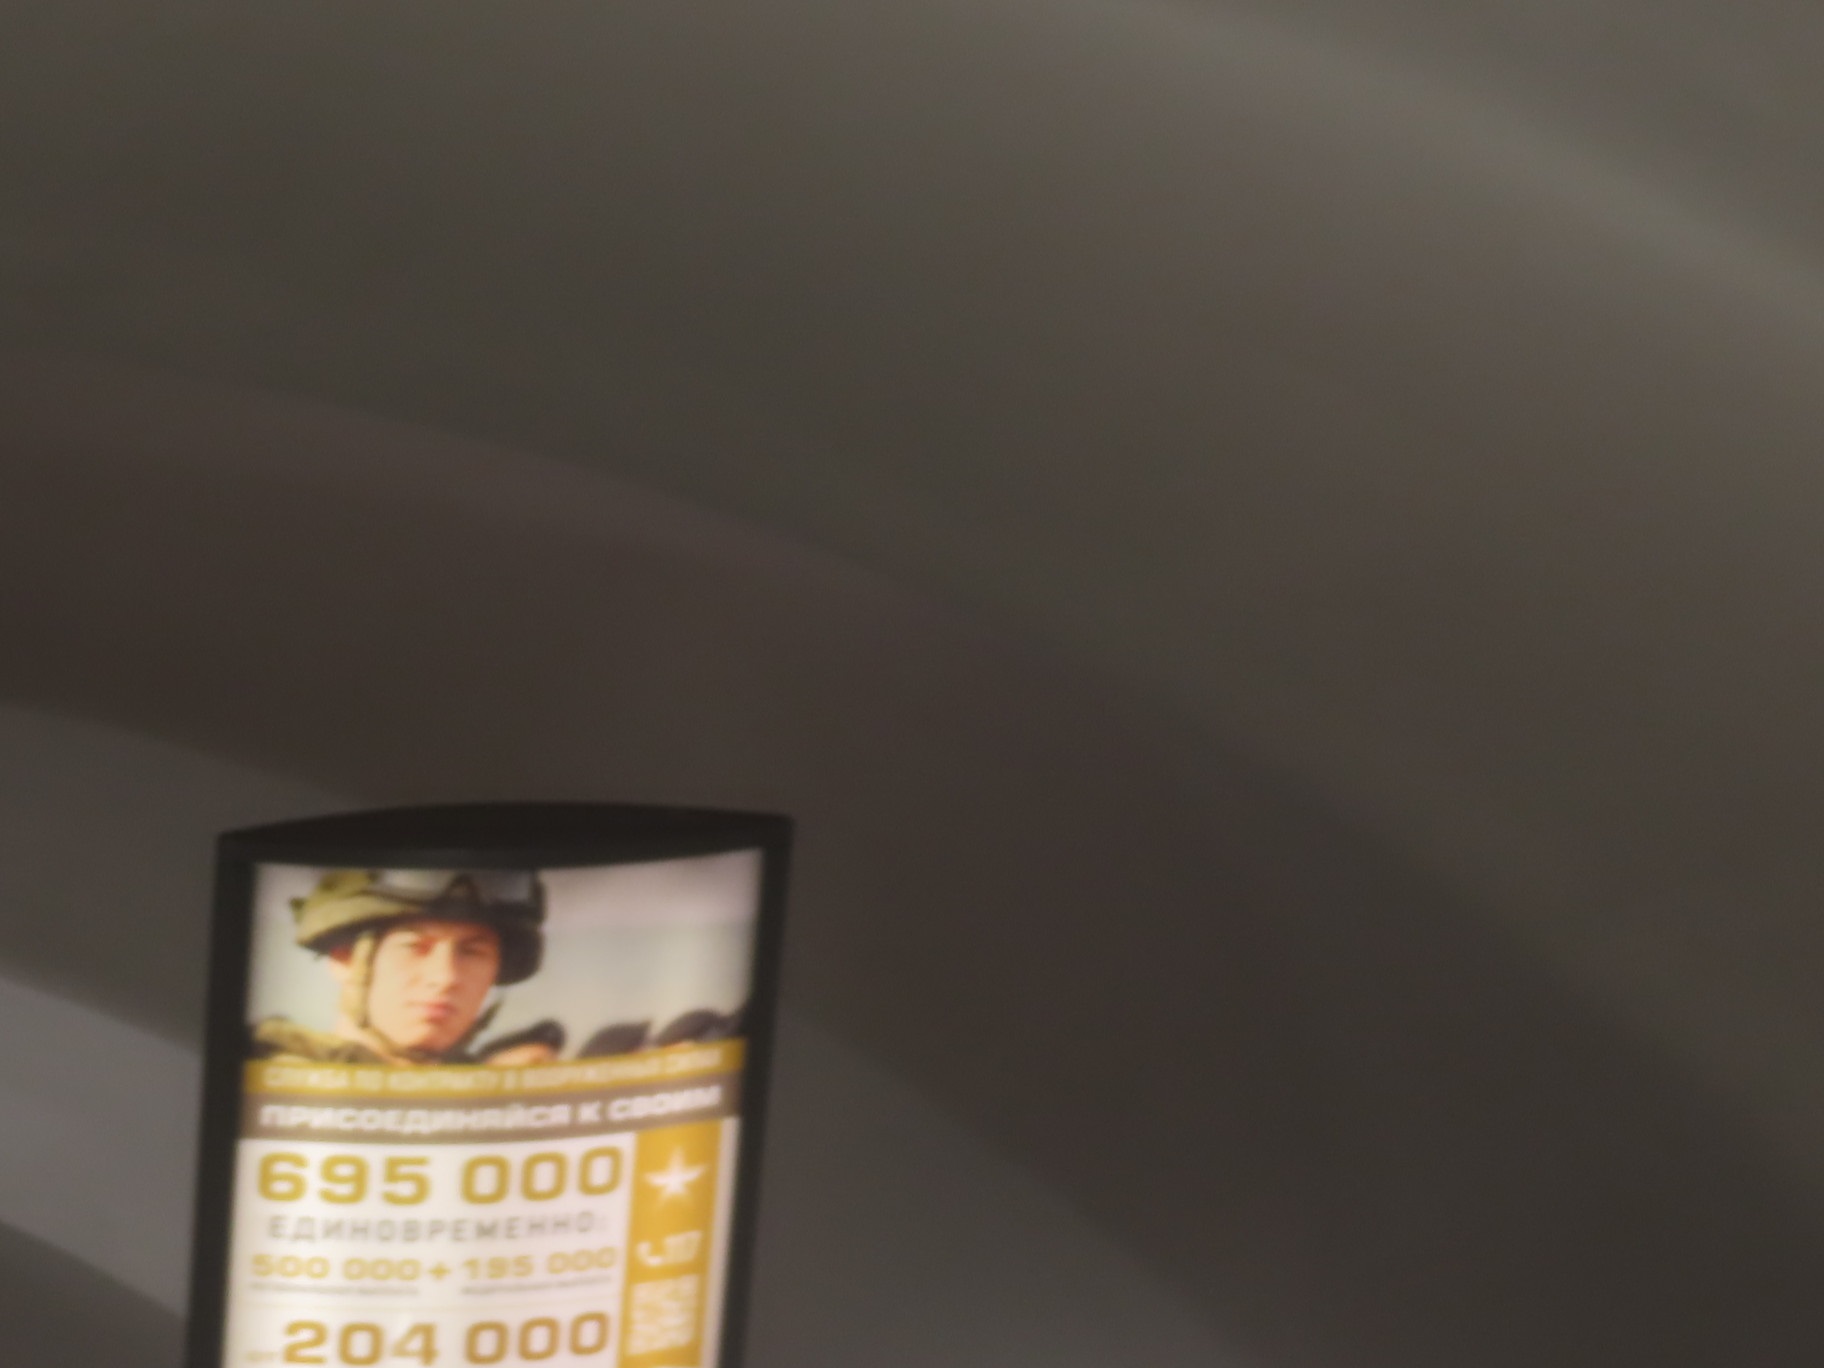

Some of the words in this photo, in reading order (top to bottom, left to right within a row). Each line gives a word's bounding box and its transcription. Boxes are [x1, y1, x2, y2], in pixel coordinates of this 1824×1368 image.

[578, 1100, 601, 1123] К
[257, 1152, 431, 1206] 695
[459, 1146, 625, 1206] 000
[250, 1253, 331, 1279] 500
[342, 1257, 421, 1282] 000
[547, 1246, 618, 1276] 000
[281, 1319, 440, 1368] 204
[465, 1310, 611, 1365] 000
